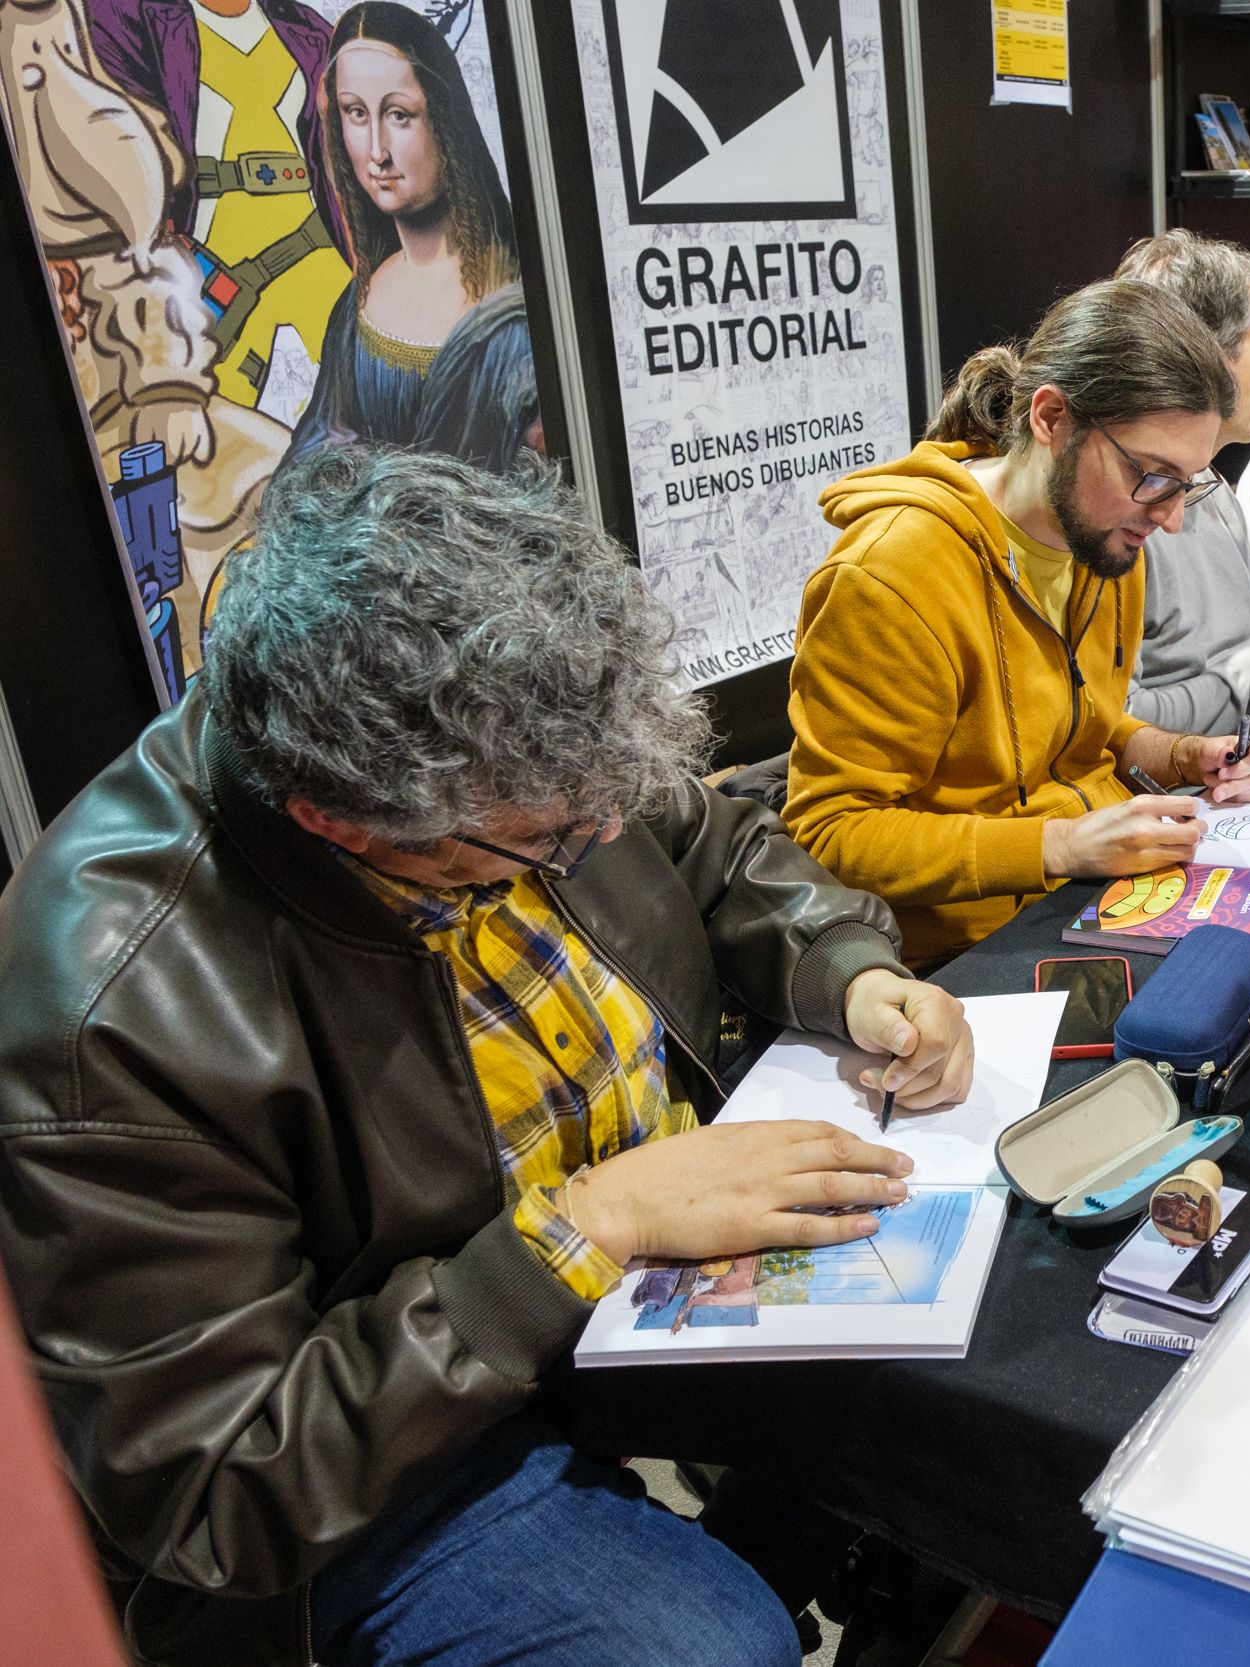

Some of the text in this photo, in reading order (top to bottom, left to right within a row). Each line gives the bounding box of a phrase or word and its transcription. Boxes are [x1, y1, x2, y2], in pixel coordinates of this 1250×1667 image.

[635, 239, 862, 310] GRAFITO
[644, 308, 867, 376] EDITORIAL
[671, 411, 864, 467] BUENAS HISTORIAS
[665, 442, 876, 505] BUENOS DIBUJANTES
[1211, 1228, 1238, 1252] MP
